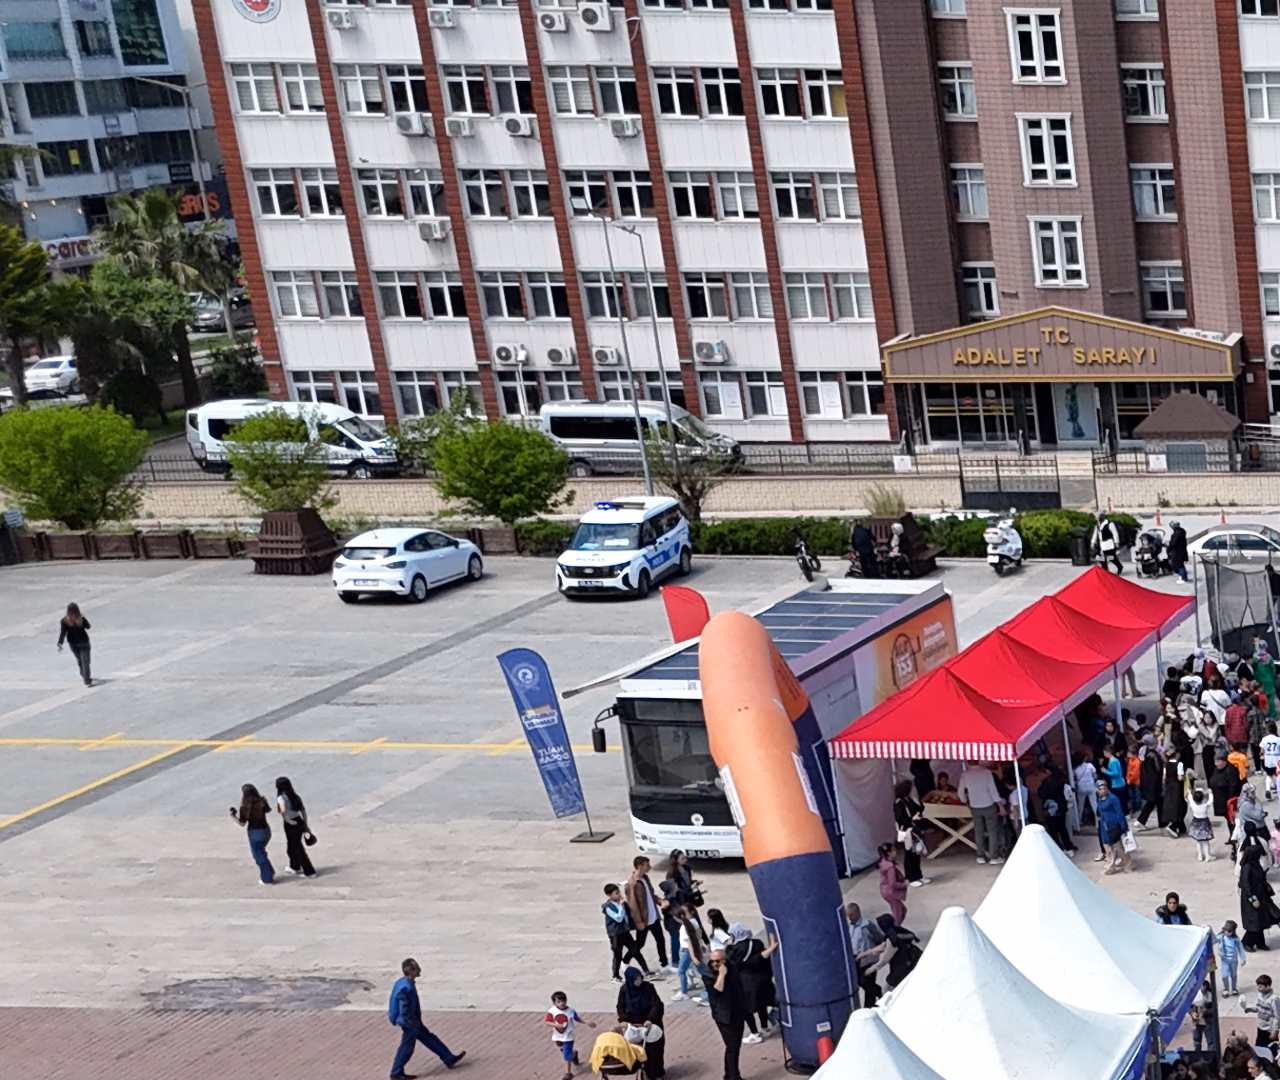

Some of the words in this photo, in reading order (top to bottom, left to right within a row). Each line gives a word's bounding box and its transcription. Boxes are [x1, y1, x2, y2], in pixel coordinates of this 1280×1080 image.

[1041, 327, 1074, 344] T.C.
[953, 347, 1041, 366] ADALET
[1073, 347, 1157, 366] SARAYI
[1266, 742, 1277, 752] 27
